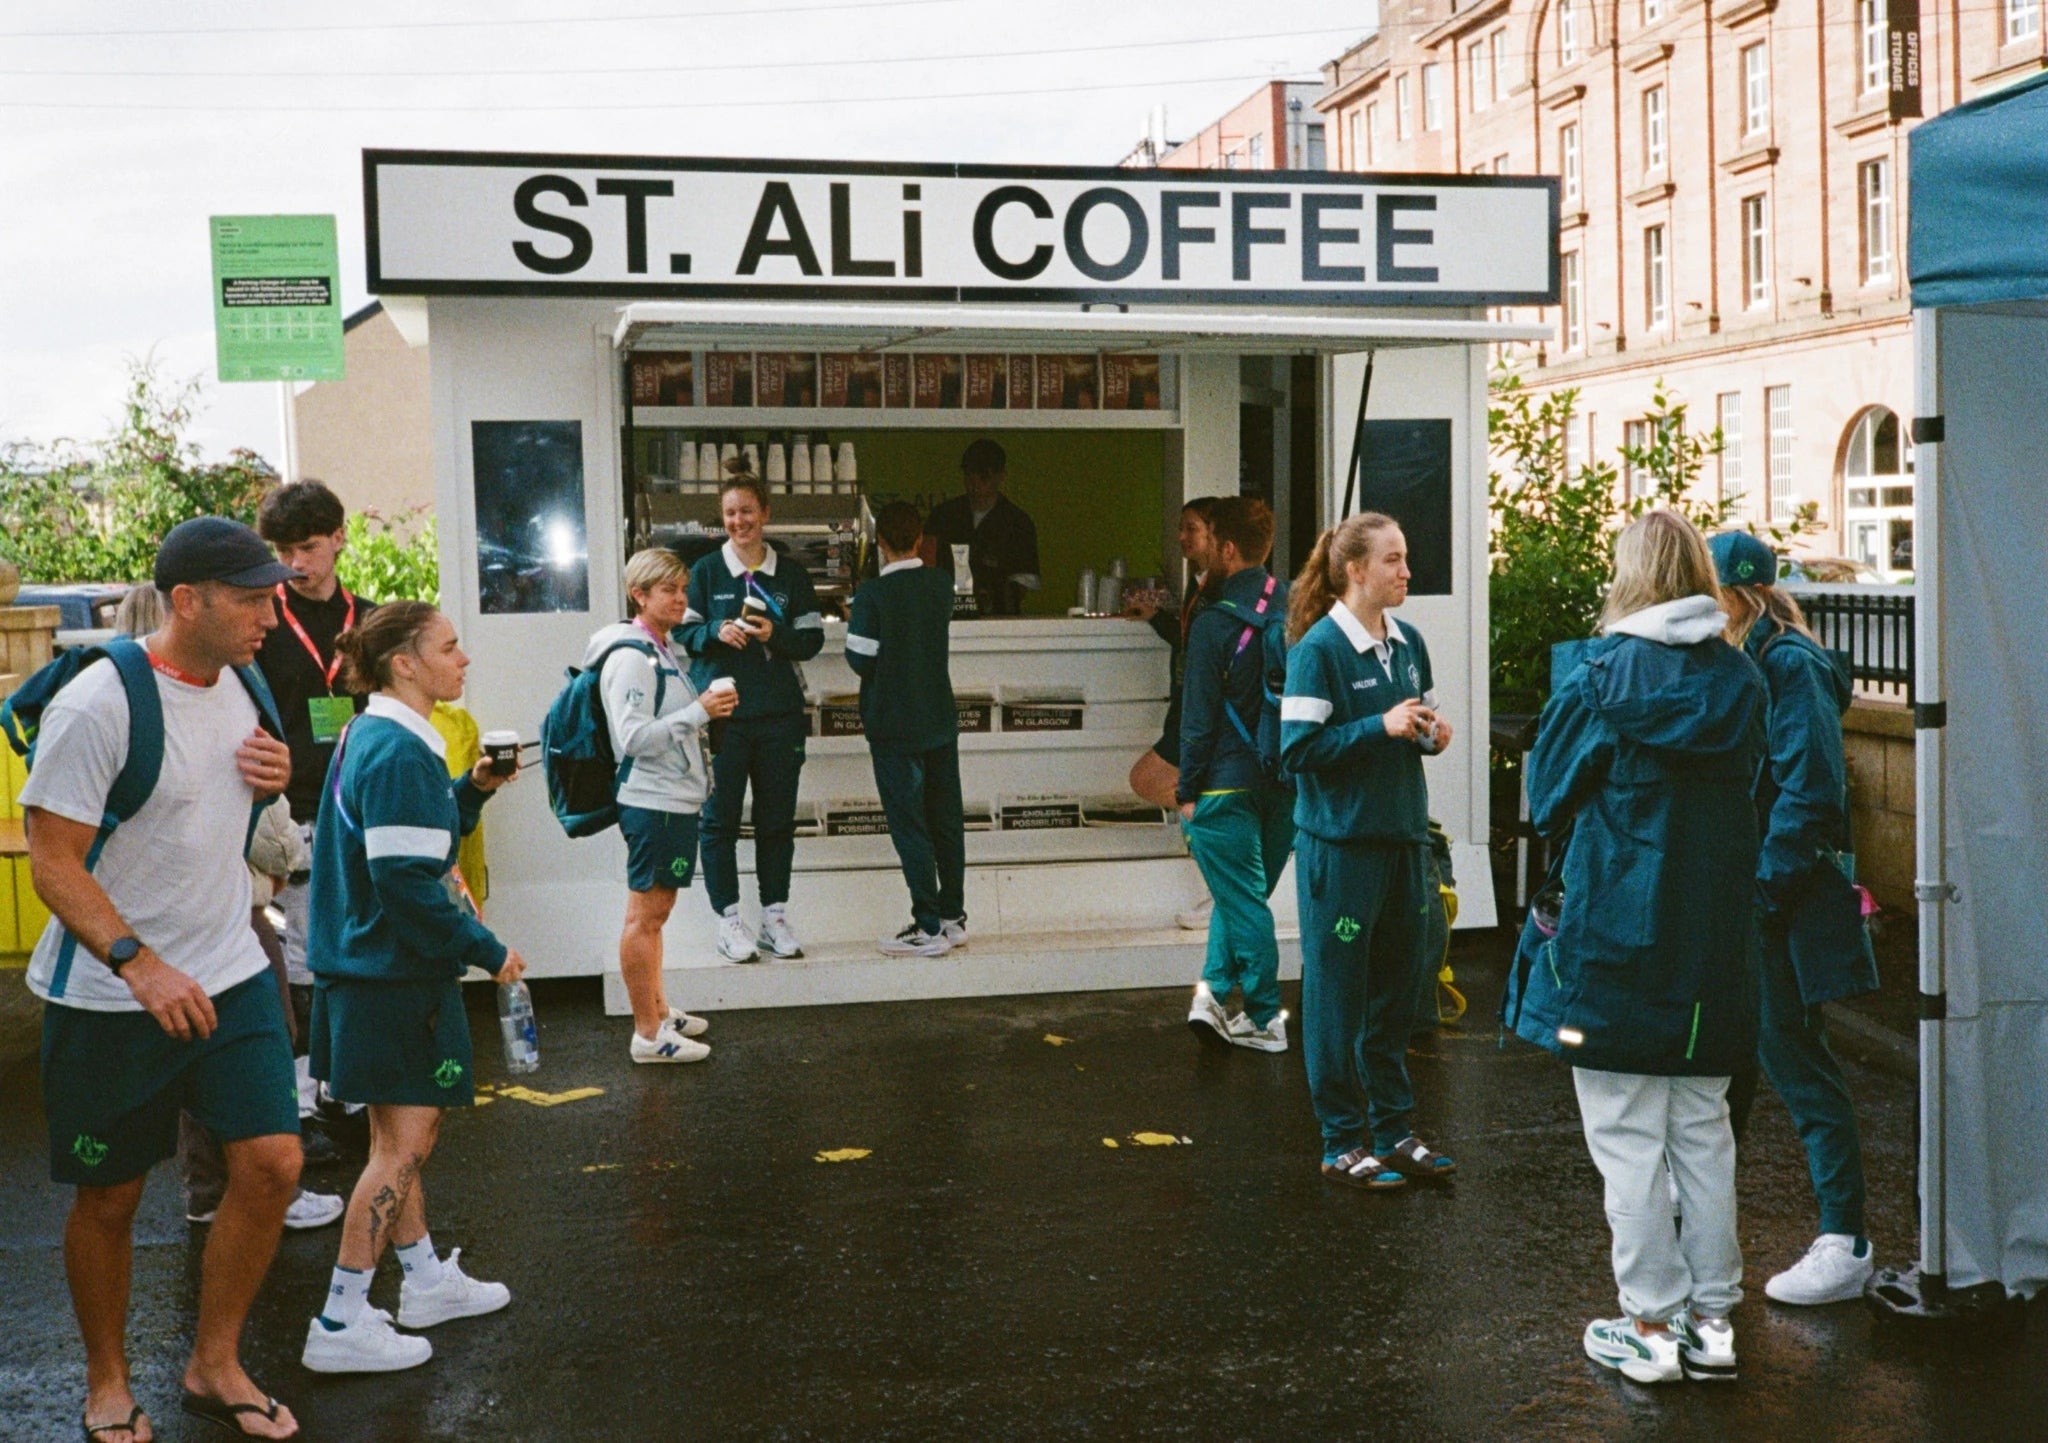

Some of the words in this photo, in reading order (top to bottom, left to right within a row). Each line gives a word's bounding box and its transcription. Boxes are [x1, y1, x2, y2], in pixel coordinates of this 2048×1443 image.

[1891, 31, 1903, 92] STORAGE
[1907, 32, 1918, 87] OFFICES
[512, 174, 691, 275] ST.
[973, 185, 1439, 283] COFFEE
[1012, 708, 1073, 719] POSSIBILITIES
[1013, 718, 1024, 726] IN
[1025, 717, 1071, 727] GLASGOW
[1012, 817, 1073, 828] POSSIBILITIES
